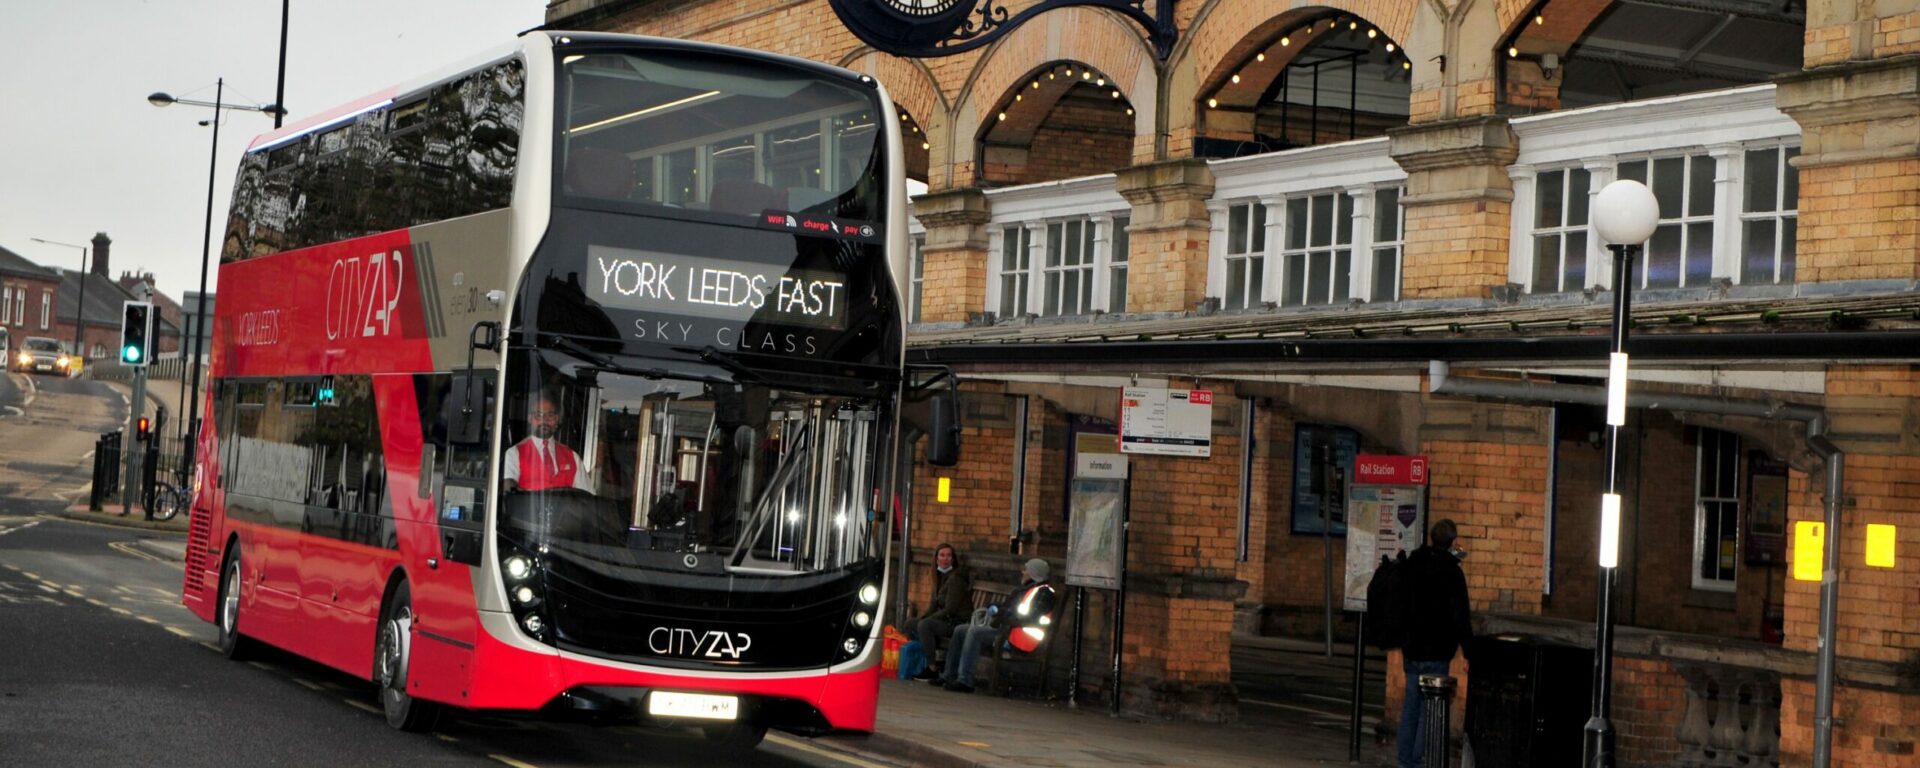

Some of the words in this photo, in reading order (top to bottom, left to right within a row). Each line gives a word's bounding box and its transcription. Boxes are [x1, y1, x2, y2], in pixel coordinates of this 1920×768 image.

[767, 214, 785, 225] WiFi
[802, 219, 830, 231] charge
[843, 225, 859, 235] pay
[326, 249, 403, 341] CITYZAP
[598, 257, 676, 301] YORK
[687, 267, 767, 309] LEEDS
[777, 277, 843, 317] FAST
[256, 309, 280, 345] LEEDS
[634, 319, 693, 342] SKY
[716, 327, 817, 355] CLASS
[1199, 394, 1211, 402] RB
[1089, 460, 1112, 470] Information
[1360, 463, 1372, 474] Rail
[1372, 464, 1395, 476] Station
[1412, 465, 1422, 476] RB
[648, 627, 752, 659] CITYZAP
